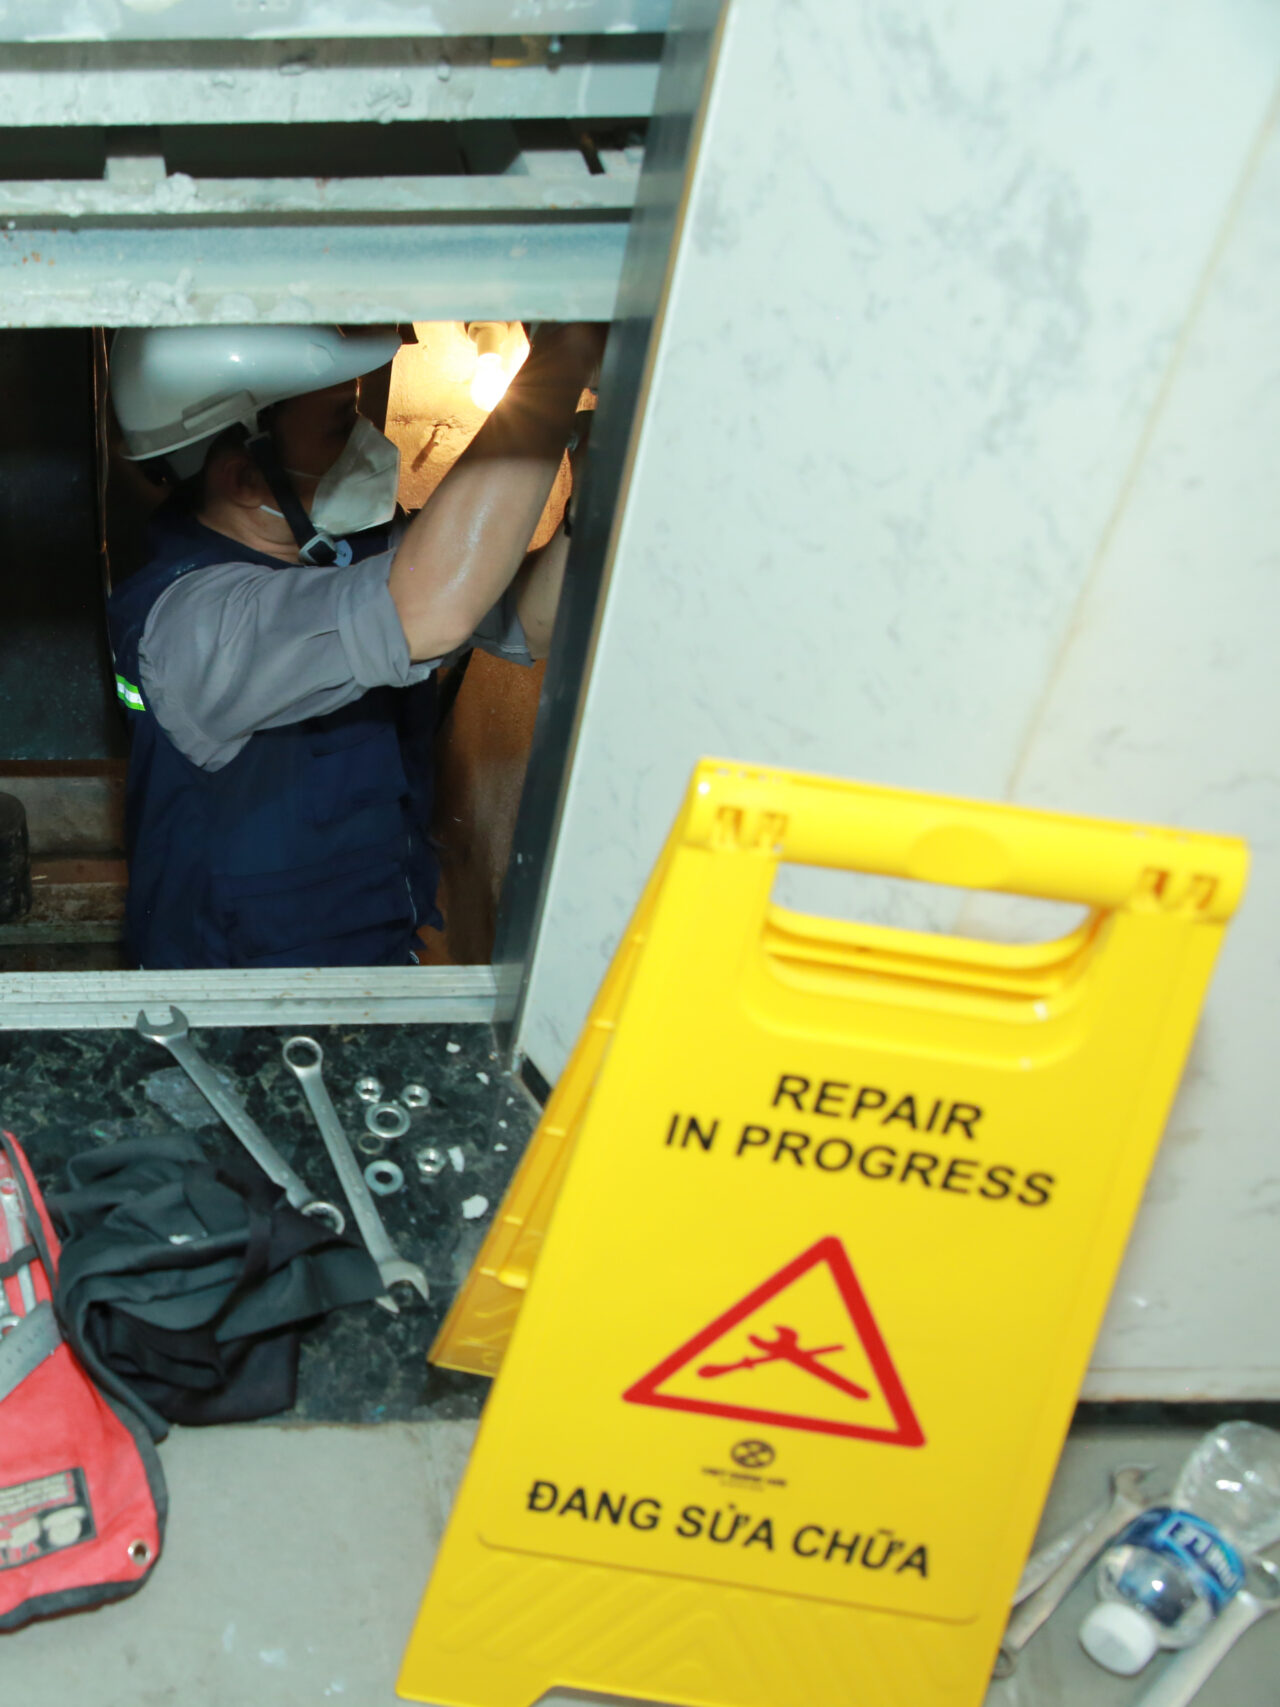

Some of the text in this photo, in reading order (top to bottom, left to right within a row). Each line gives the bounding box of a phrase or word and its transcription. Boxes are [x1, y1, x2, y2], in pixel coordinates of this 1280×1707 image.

[771, 1073, 983, 1140] REPAIR
[665, 1113, 1055, 1207] IN PROGRESS
[526, 1480, 930, 1579] ĐANG SỬA CHỮA
